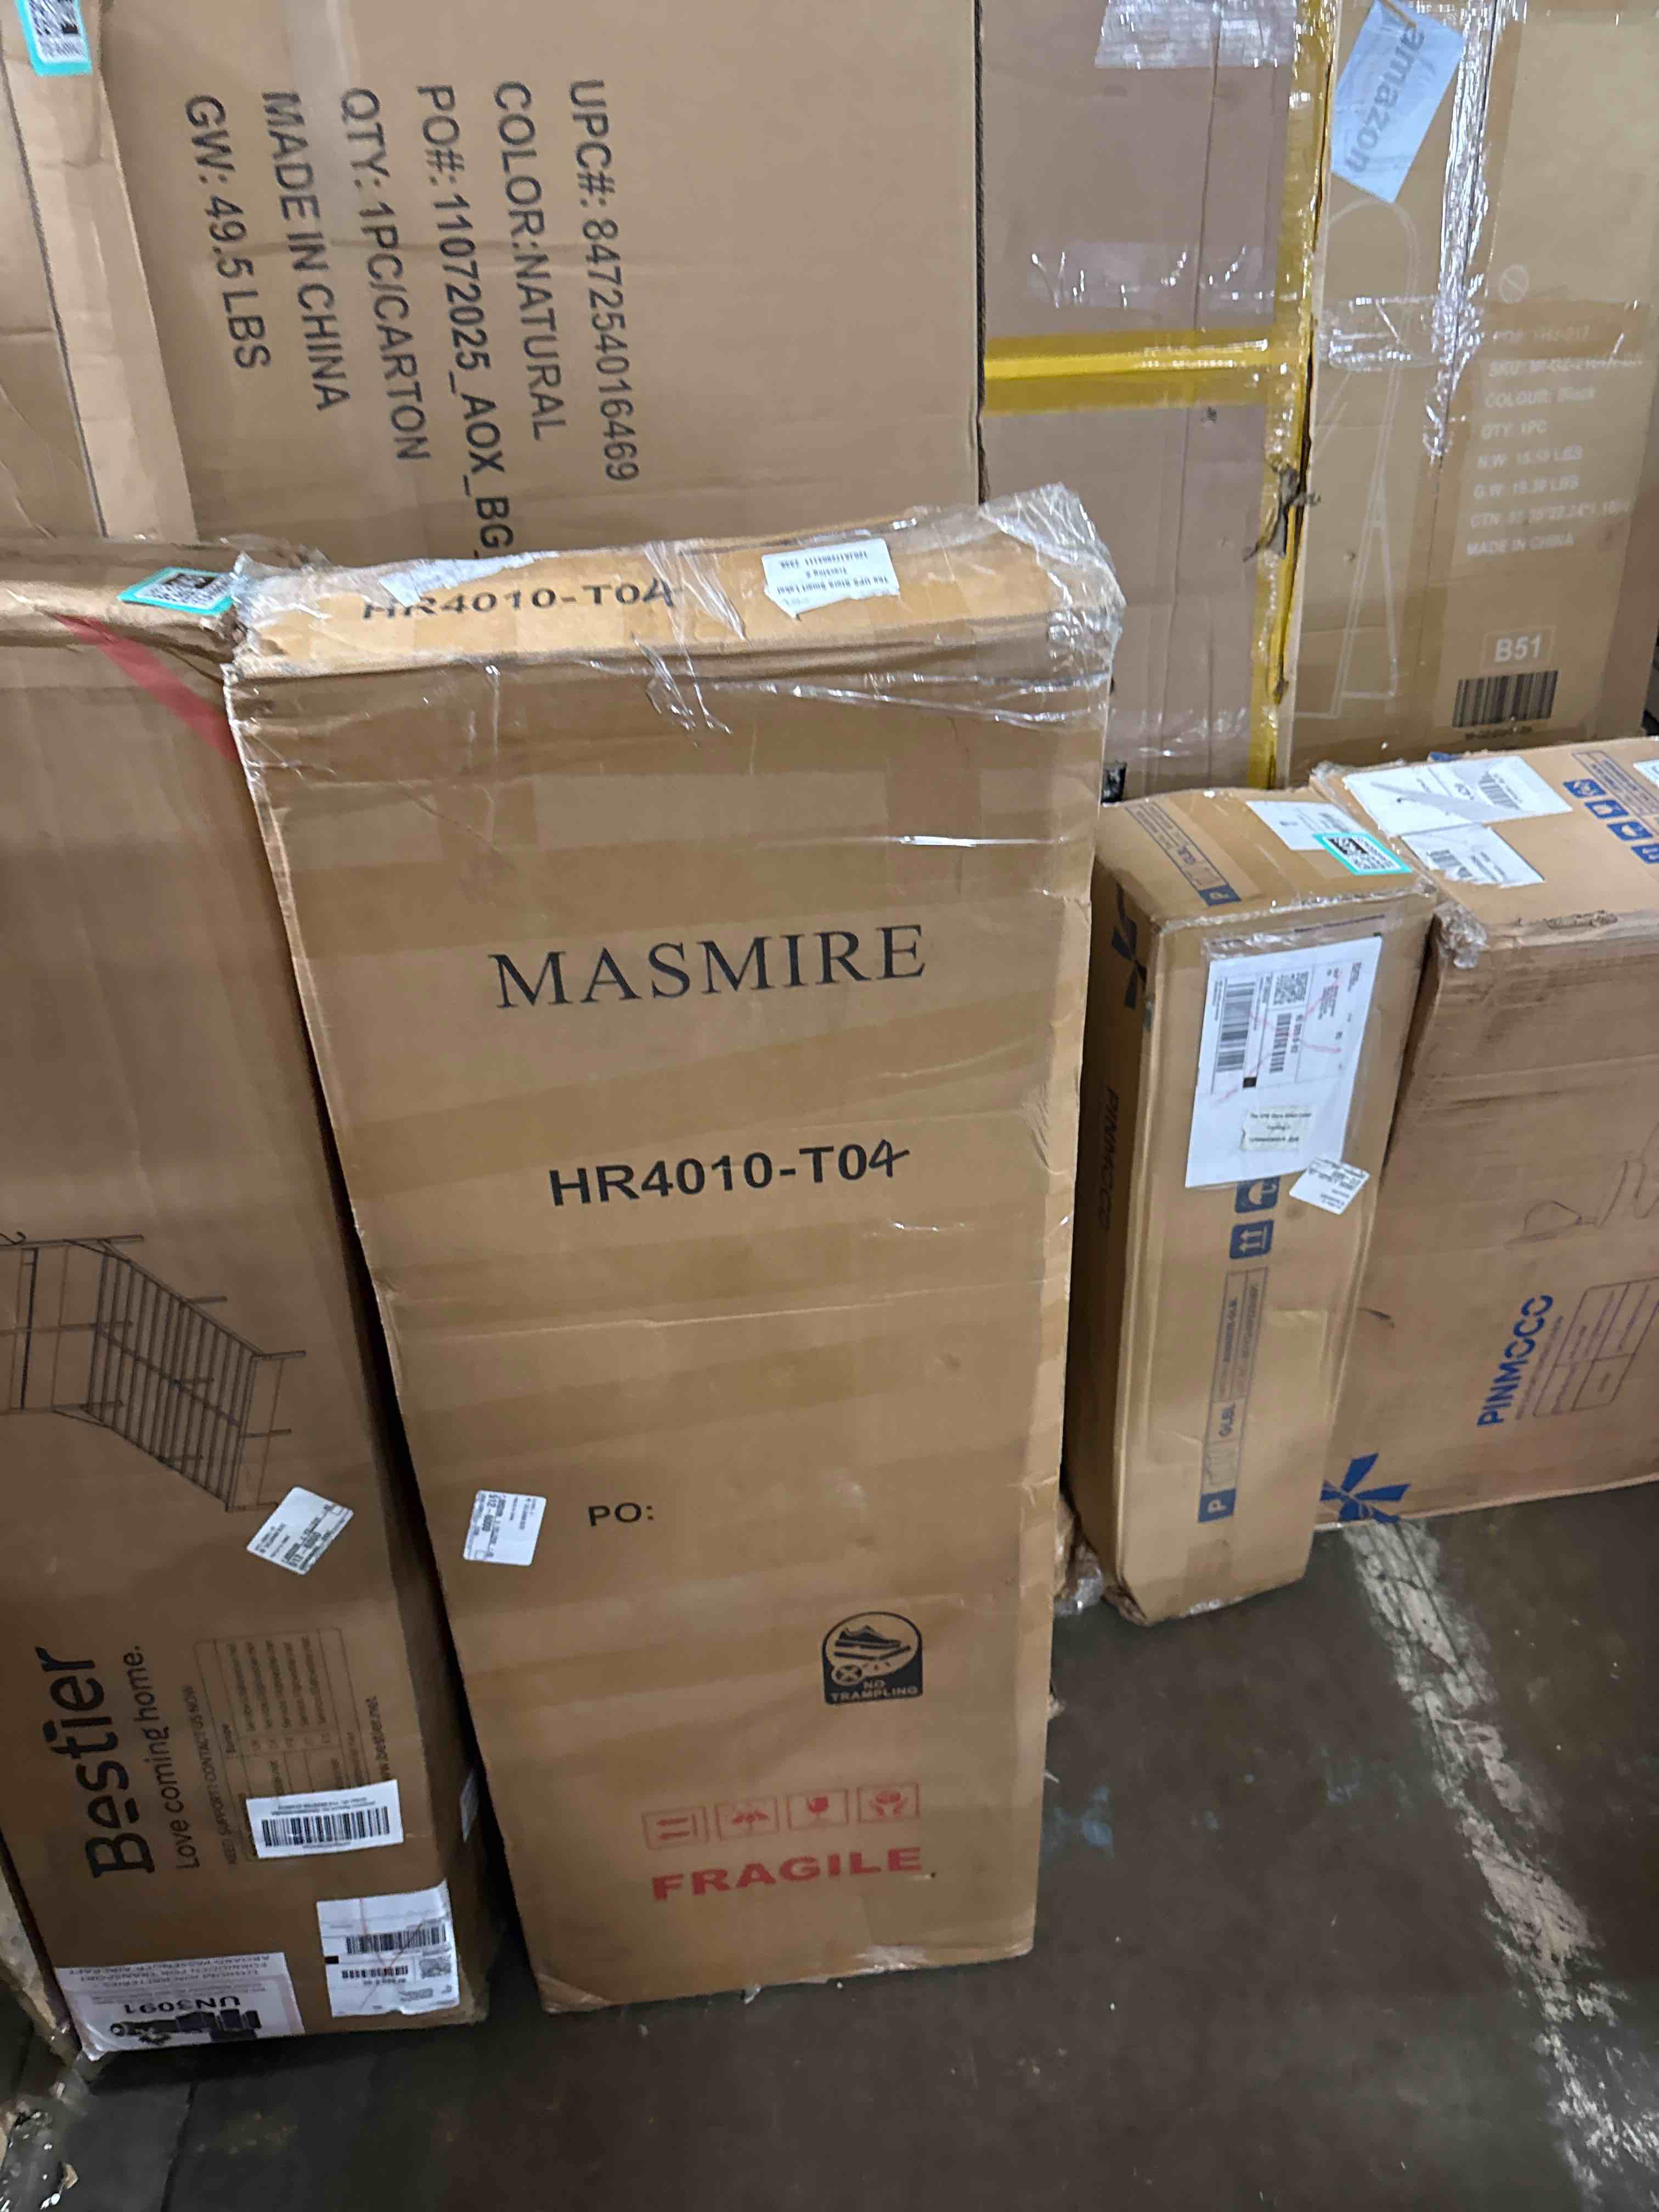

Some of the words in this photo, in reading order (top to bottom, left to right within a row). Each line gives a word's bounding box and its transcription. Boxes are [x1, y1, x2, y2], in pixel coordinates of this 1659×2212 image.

[185, 95, 235, 184] GW:
[341, 88, 390, 188] QTY:
[1346, 22, 1425, 173] amazon
[262, 92, 320, 221] MADE
[570, 80, 615, 207] UPC#:
[205, 195, 254, 279] 49.5
[286, 232, 329, 271] IN
[223, 290, 272, 369] LBS
[297, 283, 351, 411] CHINA
[358, 201, 431, 460] 1PC/CARTON
[582, 219, 639, 481] 847254016469
[1494, 634, 1542, 662] B51
[487, 924, 926, 1008] MASMIRE
[549, 1139, 910, 1206] HR4010-T04
[588, 1502, 654, 1527] PO:
[123, 1646, 160, 1722] home.
[35, 1646, 156, 1880] Bestier
[143, 1726, 184, 1813] coming
[170, 1819, 200, 1869] Love
[652, 1847, 922, 1901] FRAGILE
